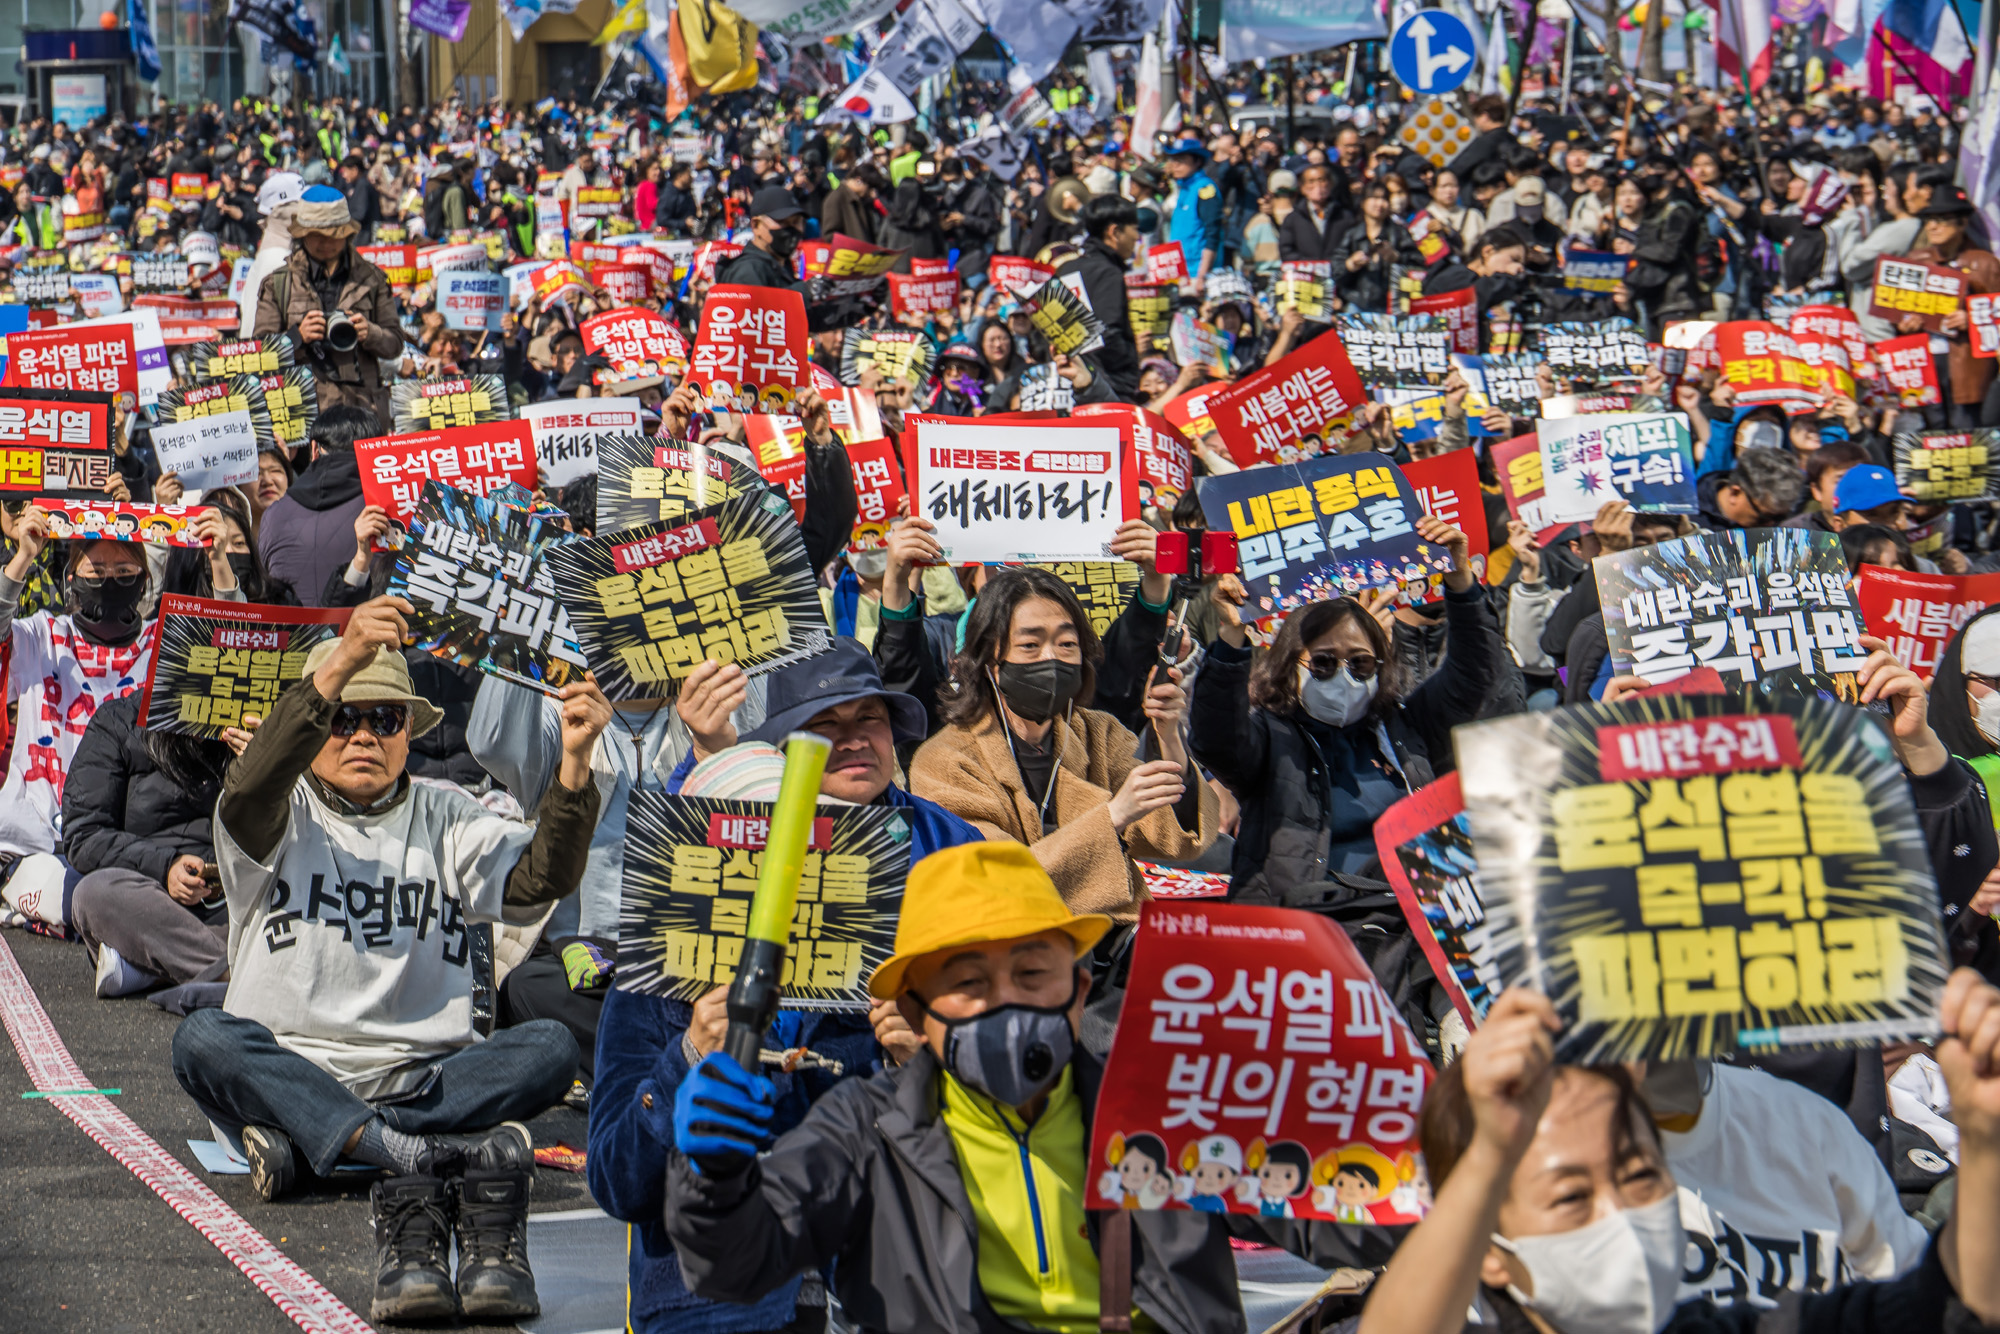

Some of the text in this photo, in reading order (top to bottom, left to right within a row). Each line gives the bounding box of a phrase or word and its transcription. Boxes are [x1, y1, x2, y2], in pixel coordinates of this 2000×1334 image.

[591, 318, 650, 346] 윤석열
[709, 306, 786, 346] 윤석열
[1345, 329, 1400, 346] 내란수괴
[1742, 330, 1801, 359] 윤석열
[17, 339, 128, 374] 윤석열 파면
[603, 337, 687, 363] 빛의 혁명
[695, 344, 799, 386] 즉각 구속
[1347, 344, 1448, 374] 즉각파면
[1547, 344, 1650, 370] 즉각파면
[425, 382, 466, 397] 내란수괴
[1724, 358, 1775, 385] 즉각
[411, 391, 491, 418] 윤석열을
[1238, 365, 1333, 429] 새봄에는
[0, 405, 92, 446] 윤석열
[390, 434, 442, 448] www.nanum.com
[536, 412, 584, 431] 란동조
[1252, 389, 1348, 455] 새나라로
[1605, 416, 1678, 458] 체포!
[0, 450, 109, 491] 면 돼지롱
[372, 438, 526, 485] 윤석열 파면
[929, 447, 1106, 473] 내란동조 국민의힘
[1551, 444, 1685, 494] 윤석열 구속!
[928, 477, 1113, 530] 해체하라!
[422, 520, 532, 585] 내란수괴
[620, 523, 705, 567] 내란수괴
[595, 536, 772, 620] 윤석열을
[168, 599, 262, 621] 나눔문화 www.nanum.com
[1621, 572, 1852, 629] 내란수괴 윤석열
[219, 629, 280, 649] 내란수괴
[620, 604, 792, 684] 파면하라
[1631, 609, 1871, 686] 즉각파면
[187, 645, 309, 680] 윤석열을
[1618, 719, 1780, 773] 내란수괴
[721, 818, 816, 846] 내란
[1551, 767, 1882, 873] 윤석열을
[1148, 911, 1307, 943] 나눔문화 www.nanum.com
[1571, 915, 1910, 1023] 파면하라
[1150, 963, 1334, 1054] 윤석열
[1161, 1053, 1425, 1143] 빛의 혁명
